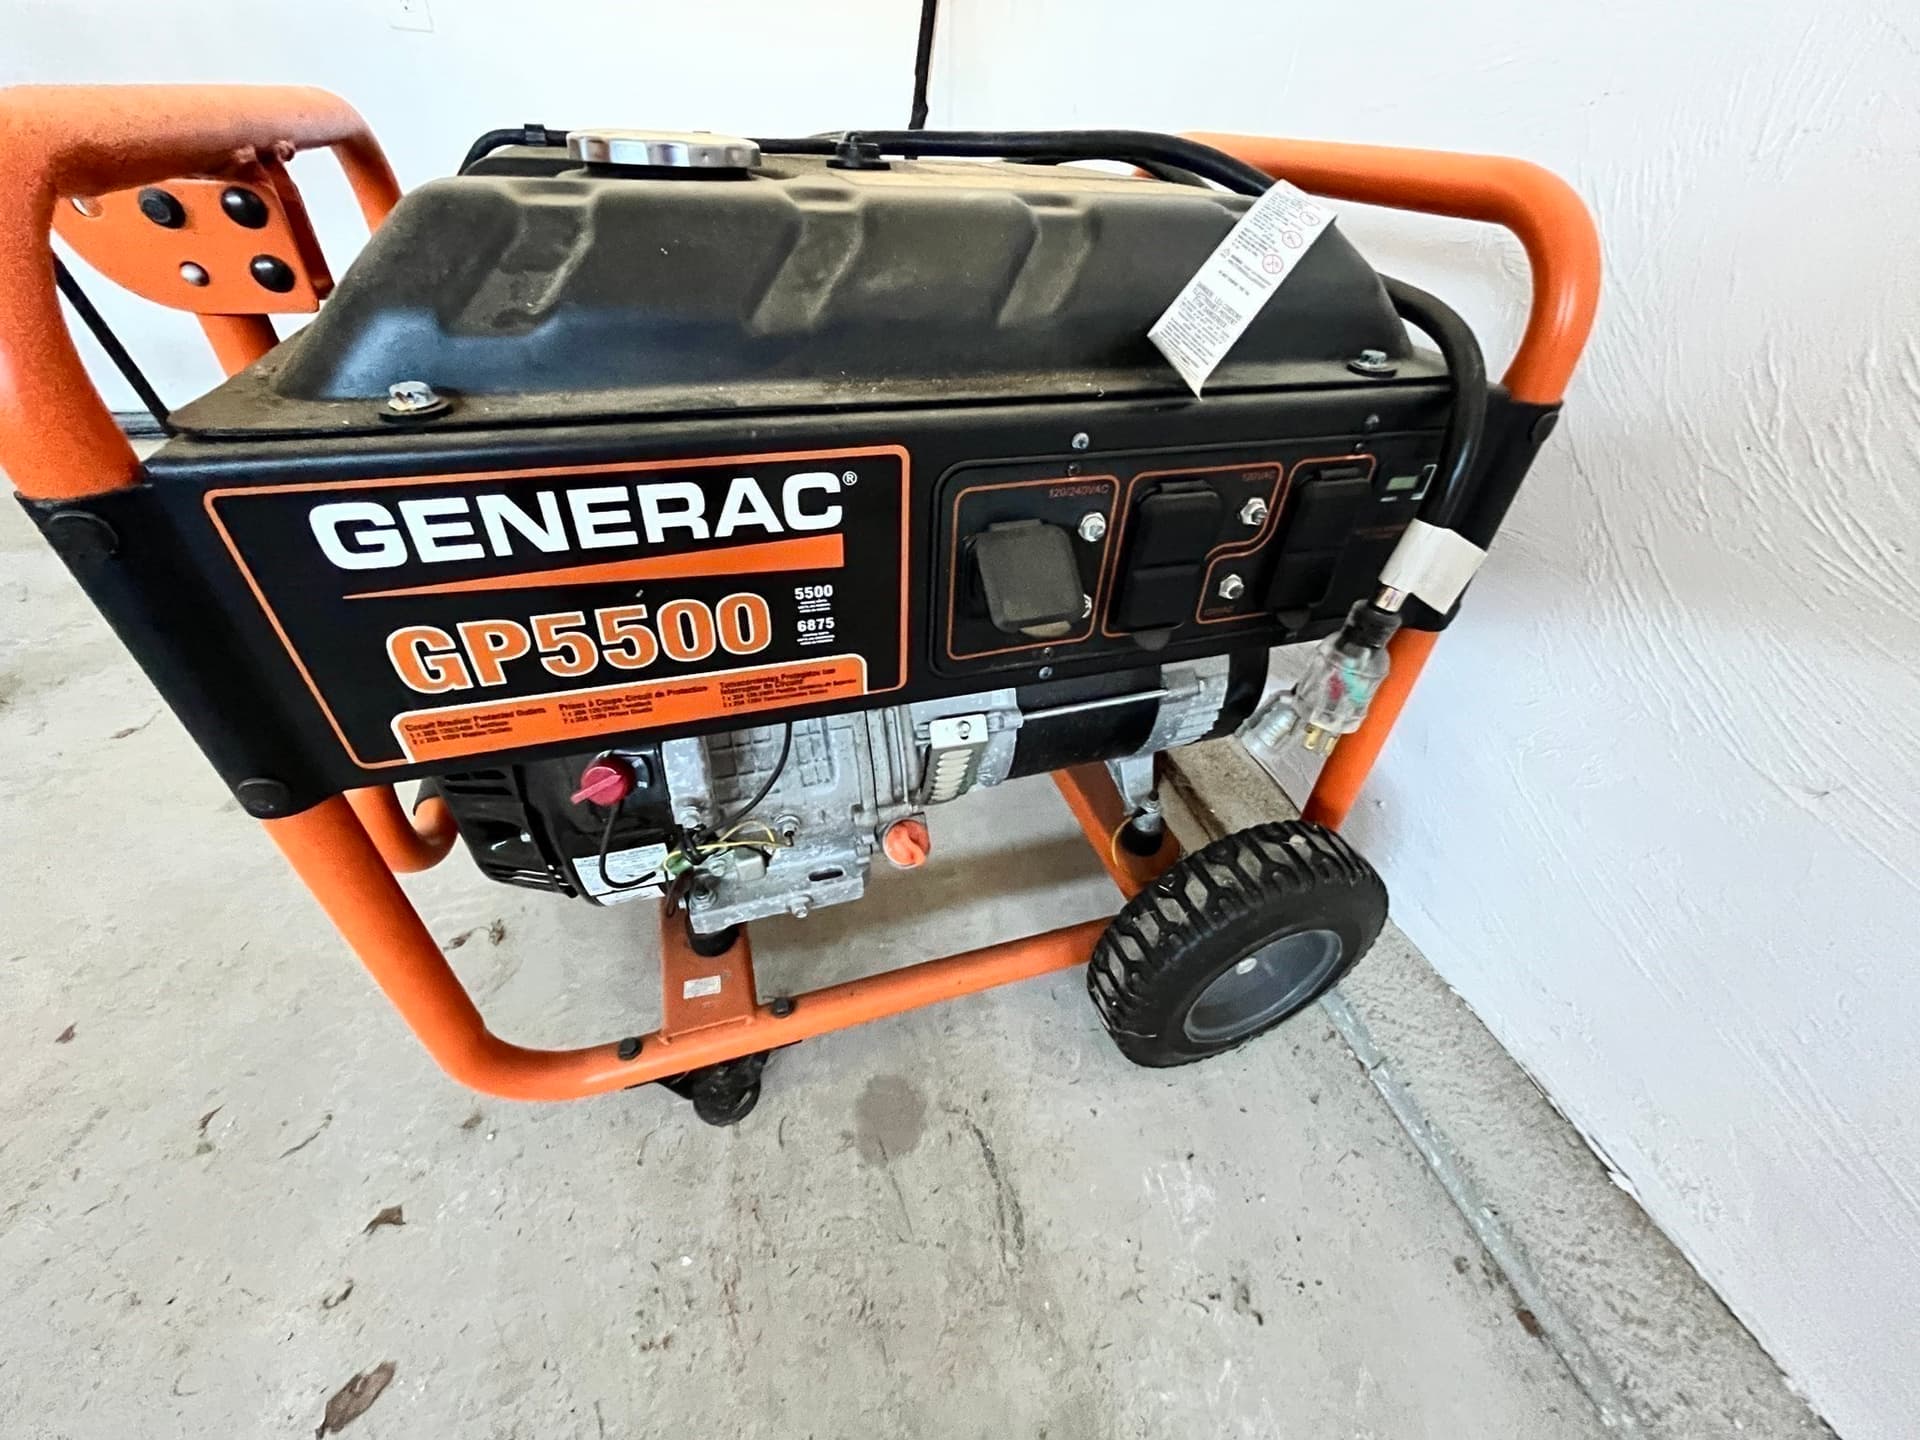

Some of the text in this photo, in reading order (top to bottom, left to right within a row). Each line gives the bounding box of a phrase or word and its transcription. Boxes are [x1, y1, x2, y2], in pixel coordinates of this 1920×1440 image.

[794, 584, 834, 600] 5500
[796, 616, 836, 633] 6875
[386, 591, 772, 695] GP5500
